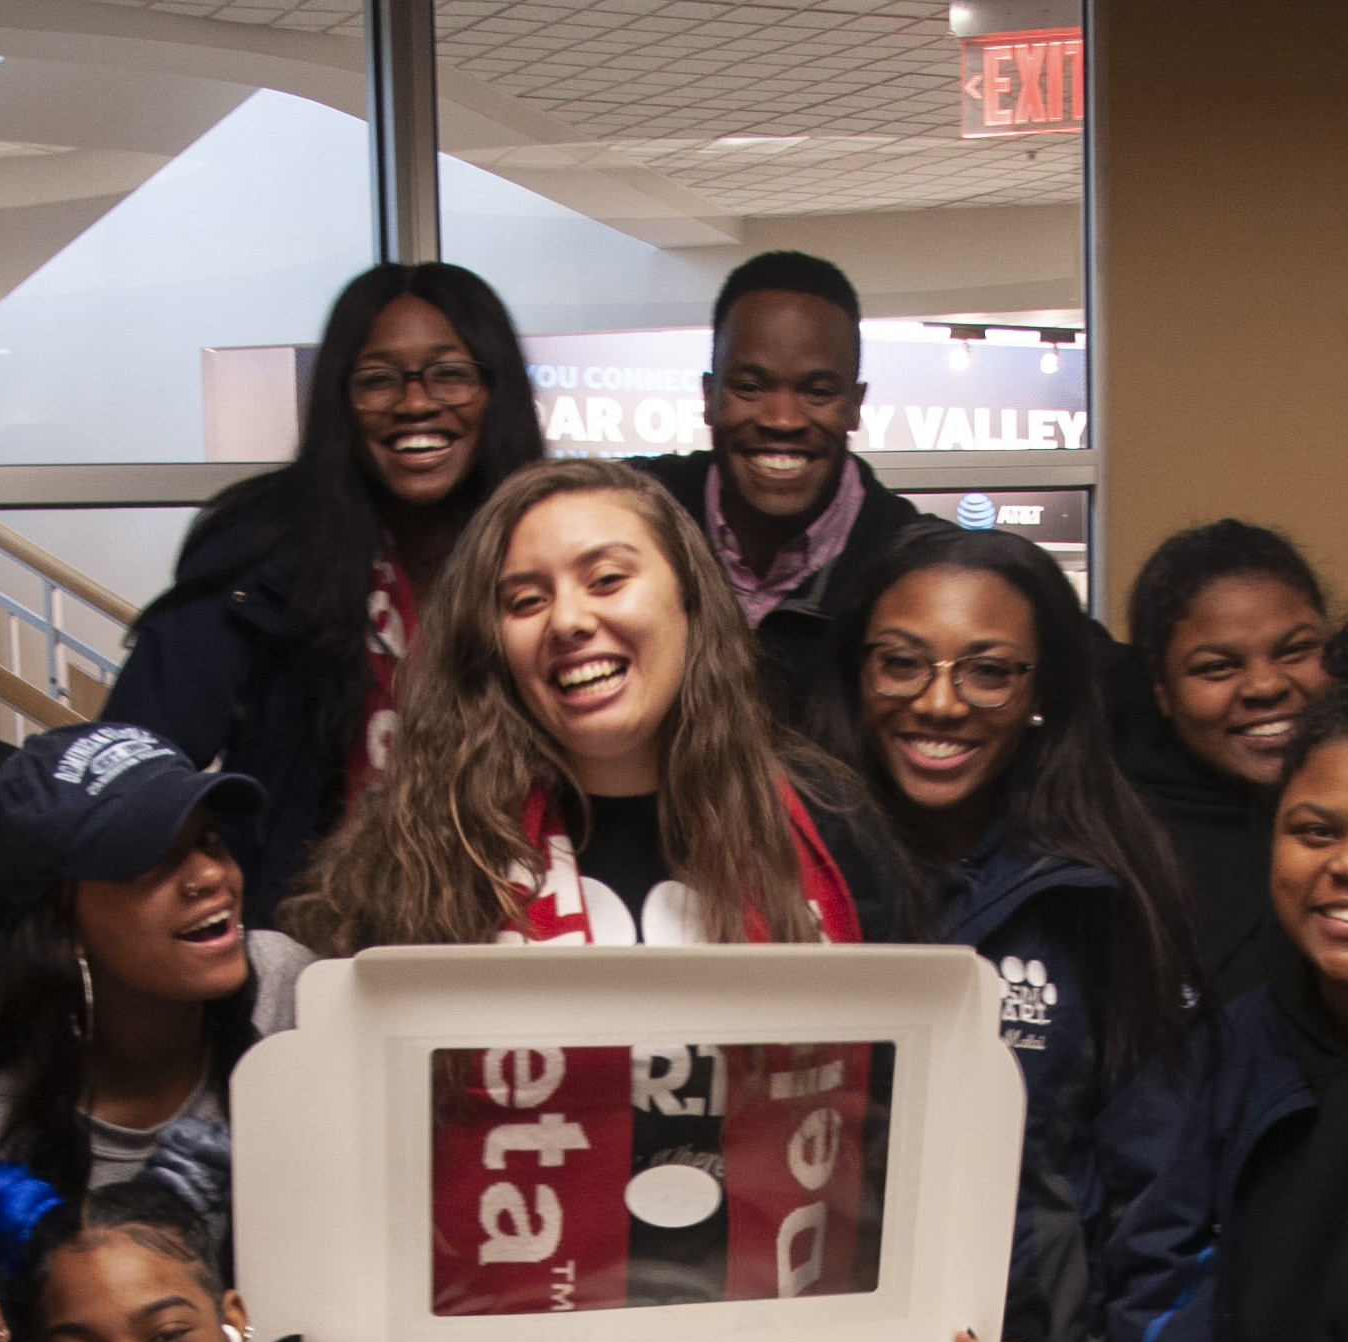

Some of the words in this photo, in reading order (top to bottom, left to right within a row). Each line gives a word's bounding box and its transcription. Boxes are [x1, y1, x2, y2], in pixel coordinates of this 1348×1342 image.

[983, 41, 1084, 126] EXIT
[583, 365, 713, 392] CONNEC
[534, 396, 626, 443] AR
[904, 406, 1088, 450] VALLEY
[996, 505, 1045, 525] AT&T
